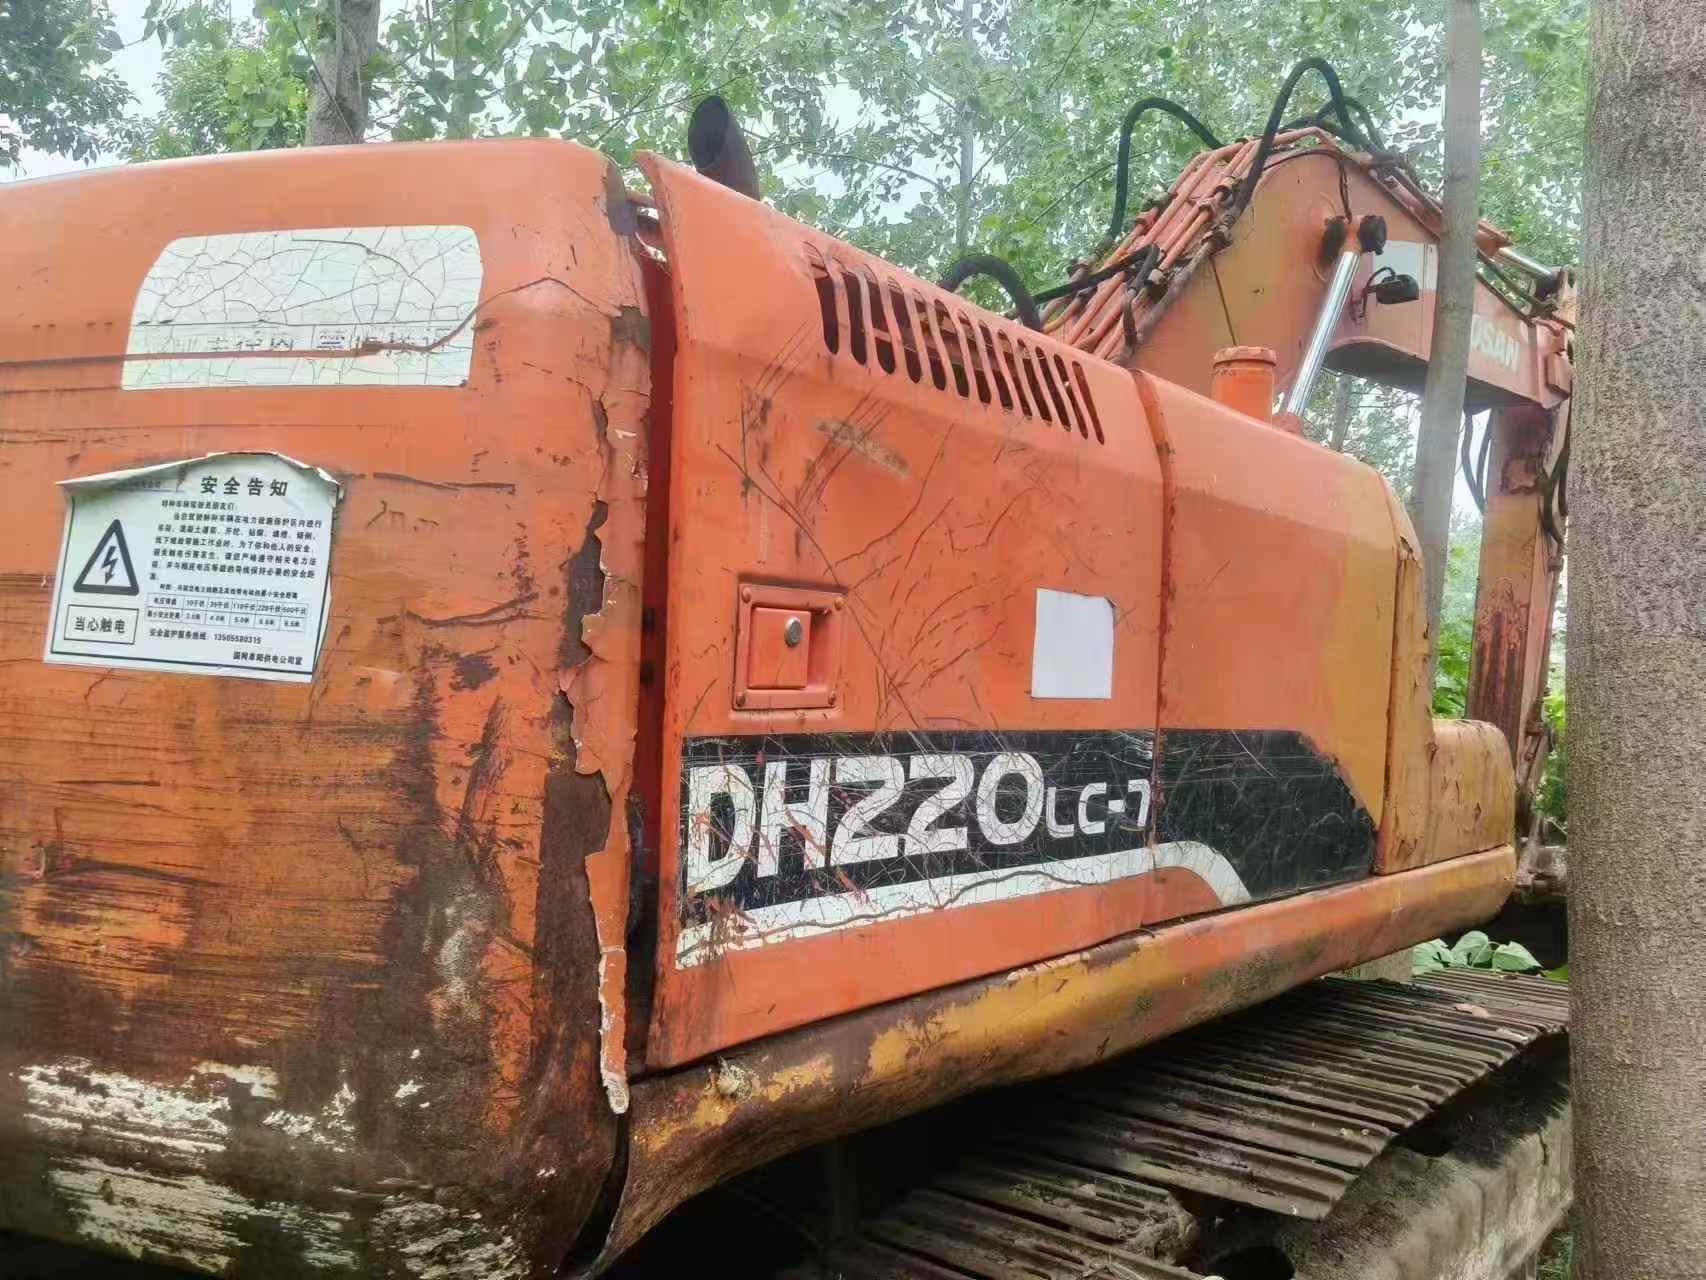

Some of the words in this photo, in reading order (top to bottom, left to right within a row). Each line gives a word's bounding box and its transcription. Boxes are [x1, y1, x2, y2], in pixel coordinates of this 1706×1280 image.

[200, 476, 289, 497] 安全告知
[73, 615, 126, 634] 当心触电
